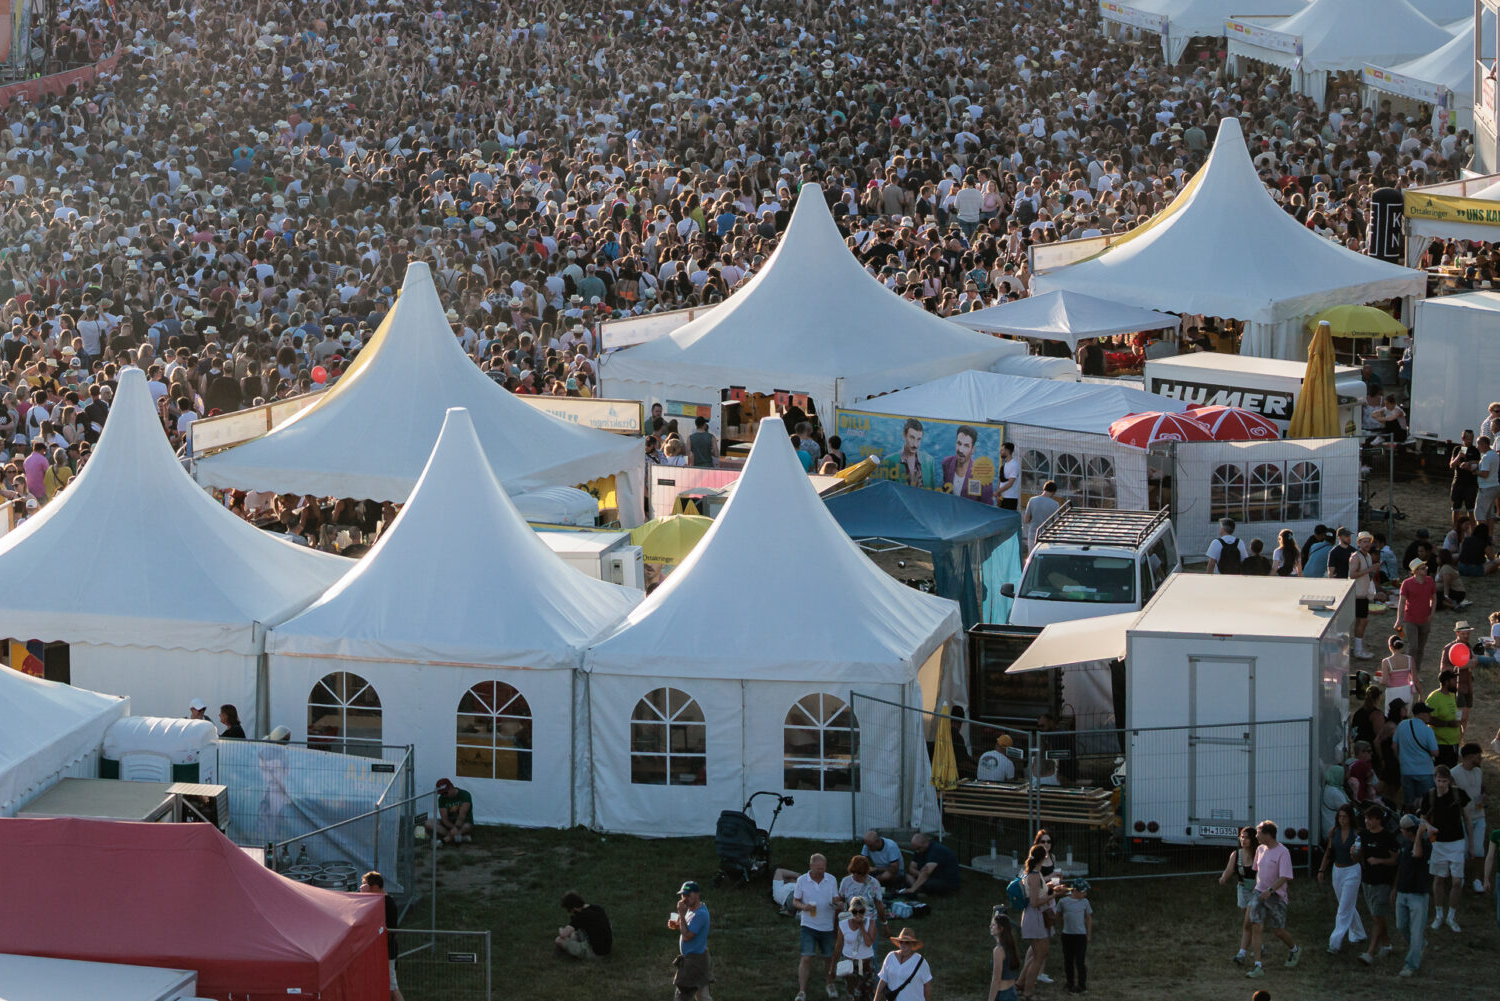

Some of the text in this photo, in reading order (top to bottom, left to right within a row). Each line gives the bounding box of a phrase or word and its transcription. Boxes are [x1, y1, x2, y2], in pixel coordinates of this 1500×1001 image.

[1410, 206, 1448, 218] Ottakringer
[1159, 384, 1288, 415] HUMER
[841, 415, 871, 431] BILLA
